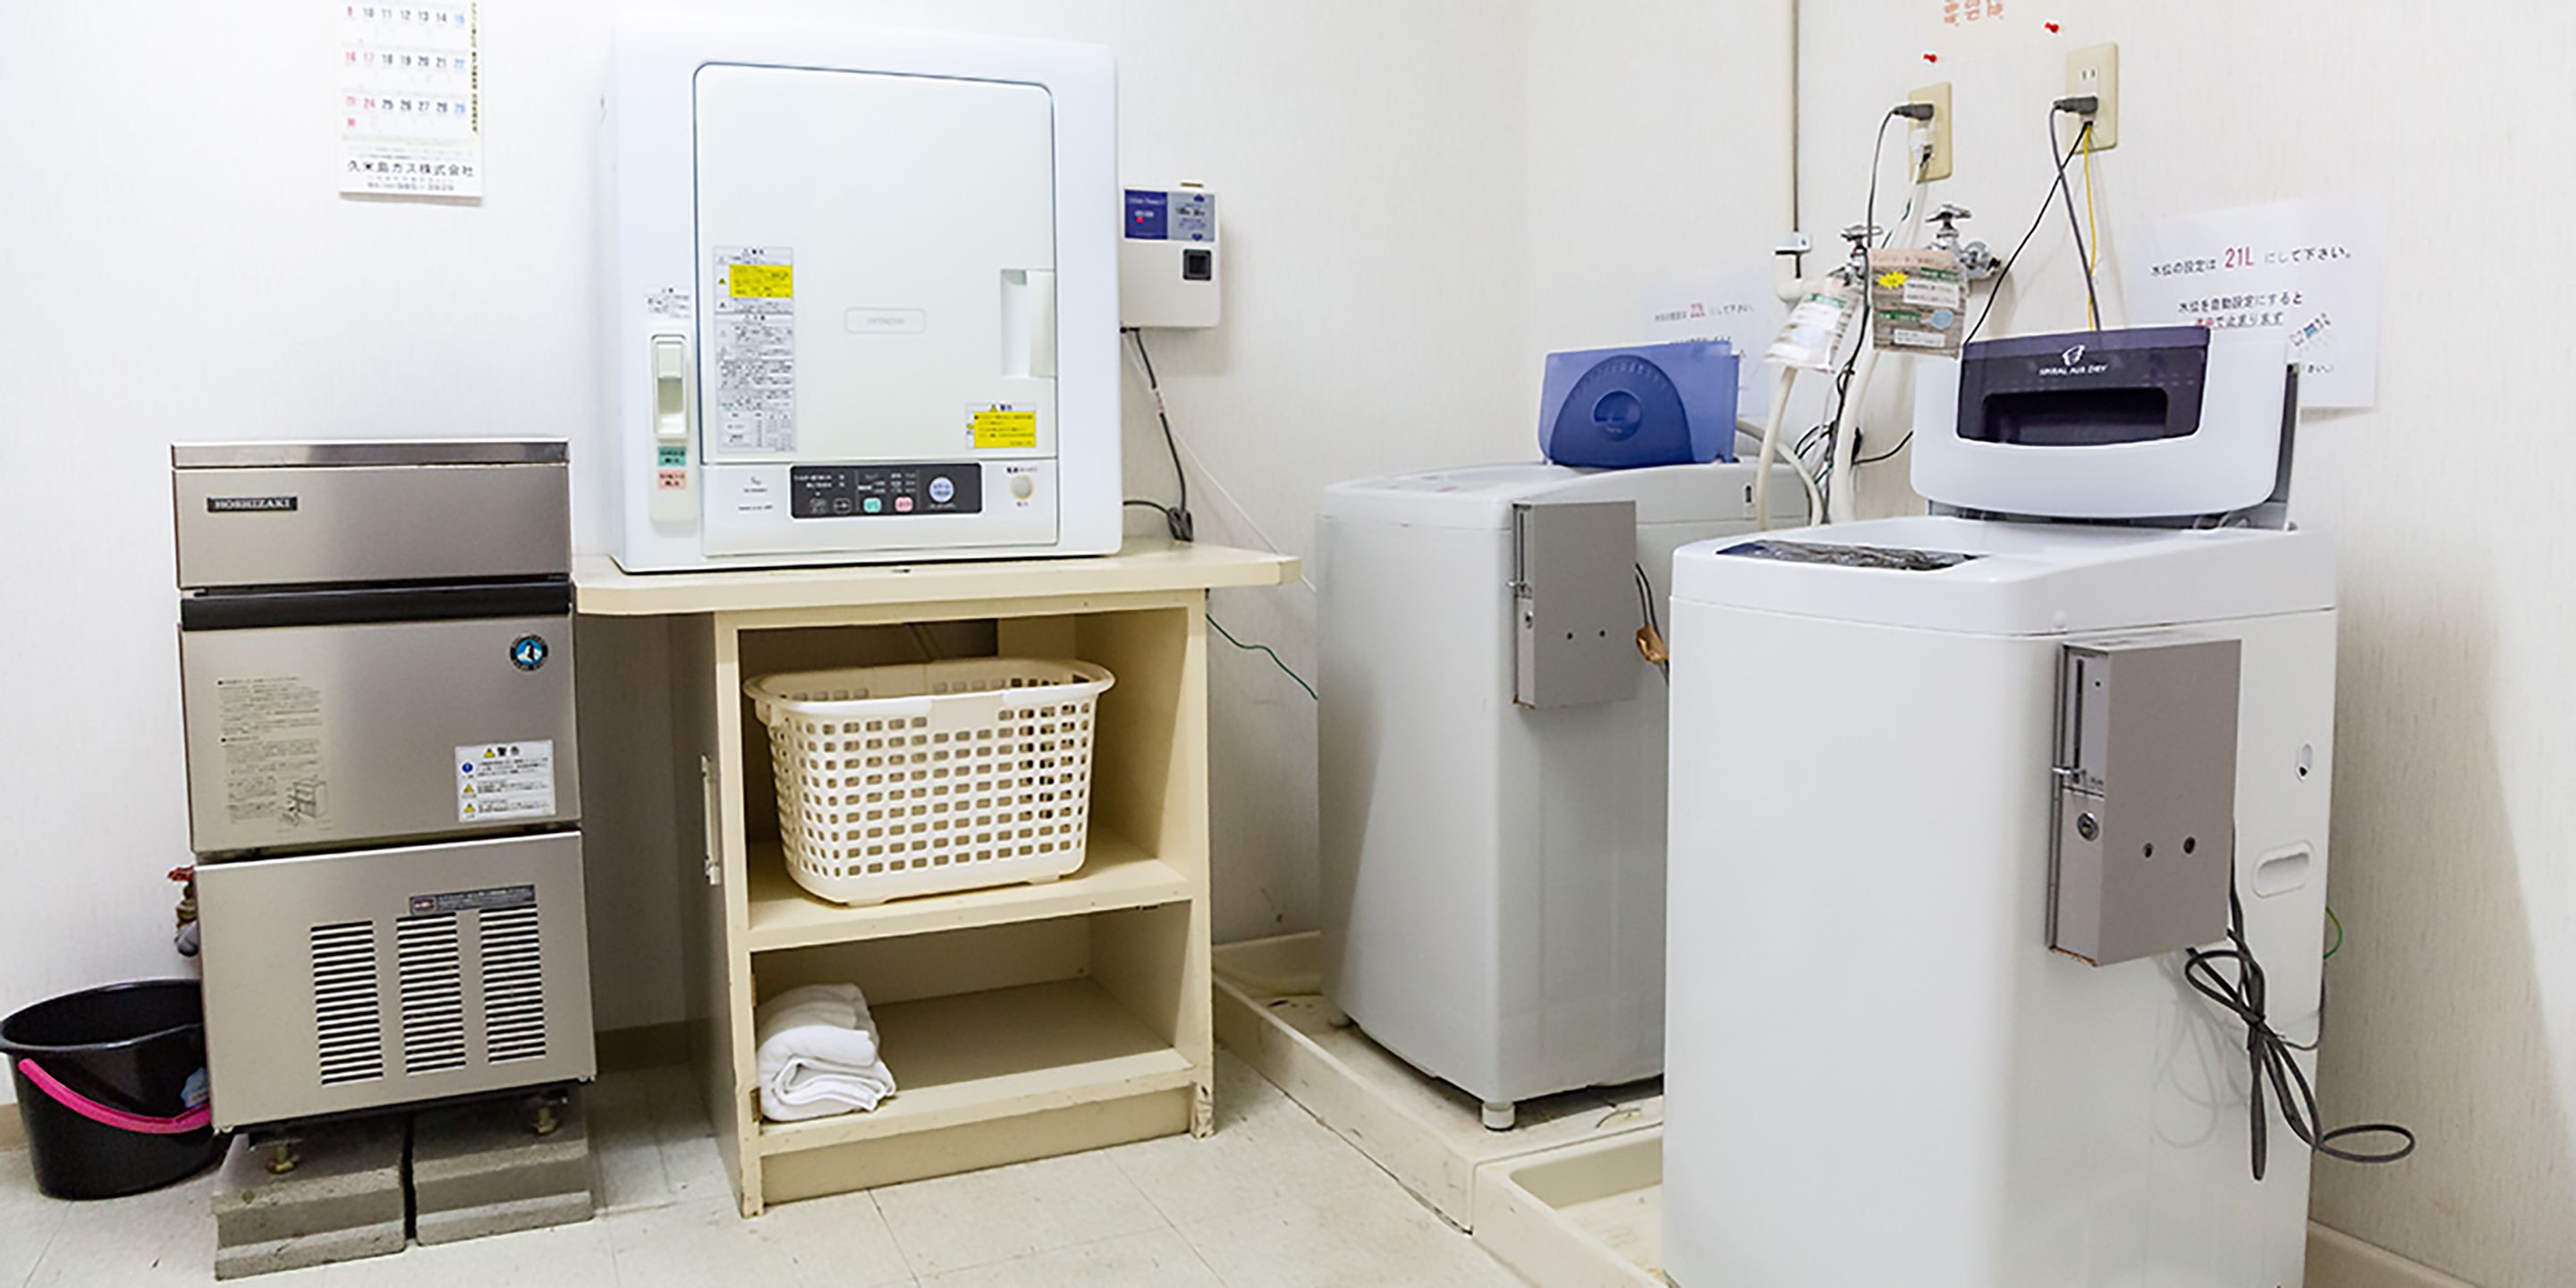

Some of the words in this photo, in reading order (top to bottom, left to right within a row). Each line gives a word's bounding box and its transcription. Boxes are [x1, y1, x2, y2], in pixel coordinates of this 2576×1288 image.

[363, 7, 375, 18] 10
[382, 8, 392, 19] 11
[401, 10, 411, 20] 12
[419, 11, 429, 21] 13
[436, 12, 447, 22] 14
[382, 54, 393, 64] 18
[401, 55, 411, 65] 19
[418, 55, 429, 67] 20
[363, 97, 376, 108] 24
[382, 98, 394, 110] 25
[401, 99, 411, 111] 26
[419, 100, 429, 112] 27
[347, 159, 474, 177] 久米島ガス株式会社
[2150, 258, 2216, 276] 水位の設定は
[2224, 246, 2255, 269] 21L
[2264, 245, 2351, 265] にして下さい。
[2038, 367, 2068, 376] SPIRAL
[2069, 366, 2086, 375] AIR
[2087, 364, 2109, 374] DRY
[215, 498, 290, 510] HOSHIZAKI
